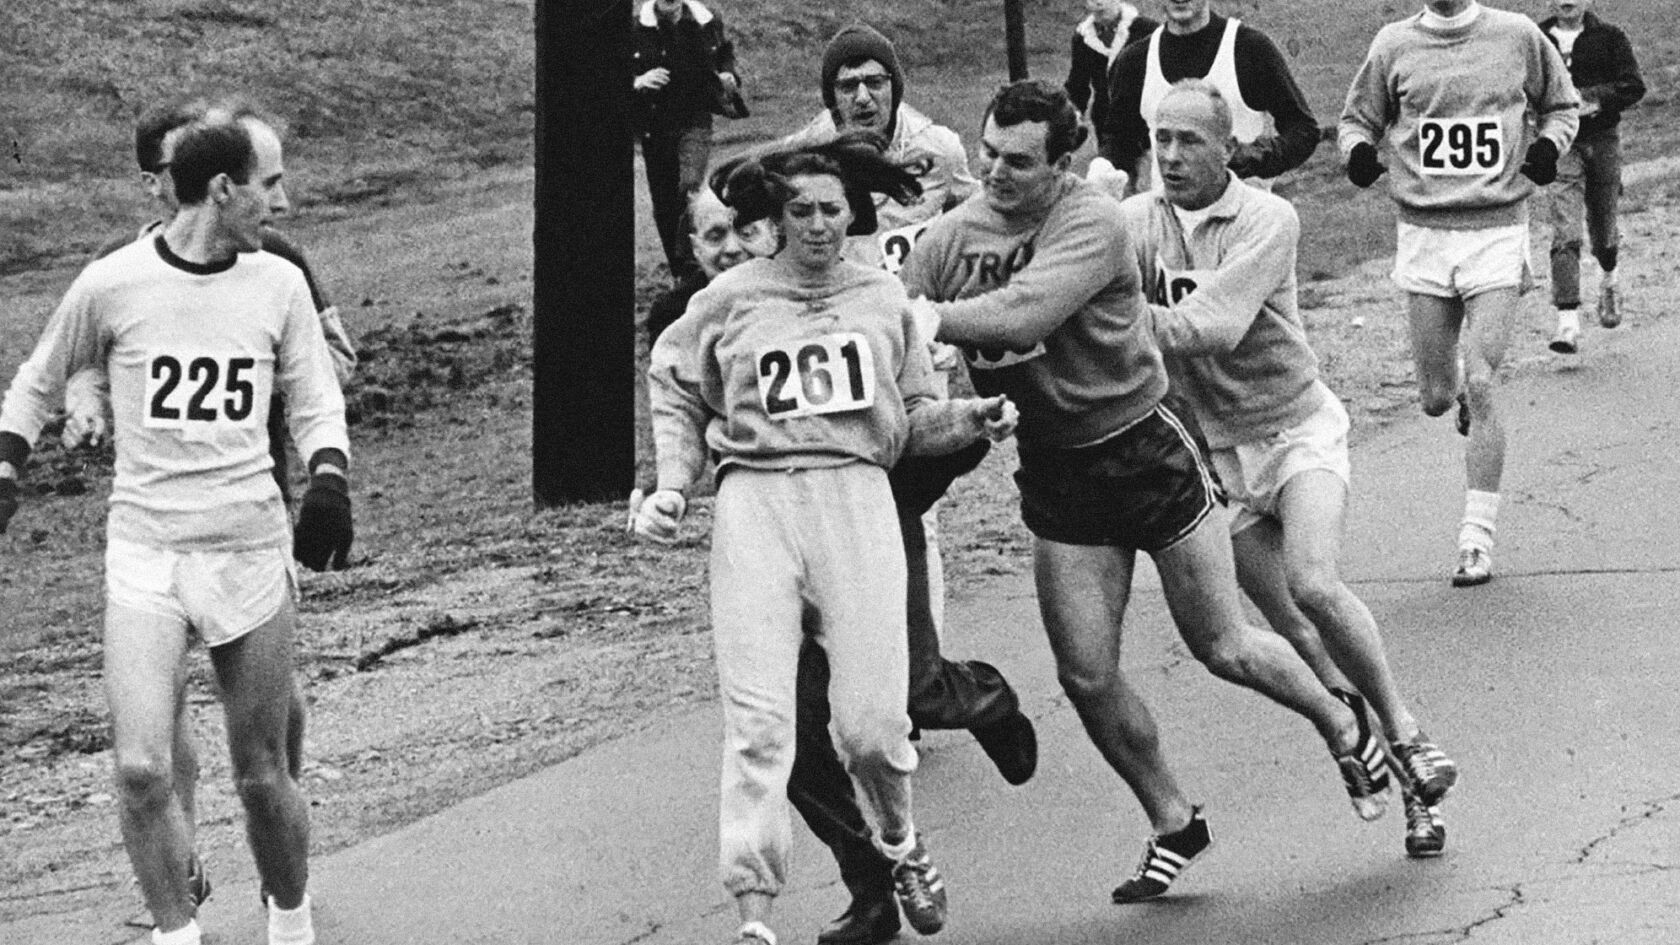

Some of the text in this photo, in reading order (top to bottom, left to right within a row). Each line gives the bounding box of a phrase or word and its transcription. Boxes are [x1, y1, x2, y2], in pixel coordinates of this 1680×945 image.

[1421, 122, 1500, 169] 295
[150, 355, 254, 421] 225
[760, 340, 865, 414] 261
